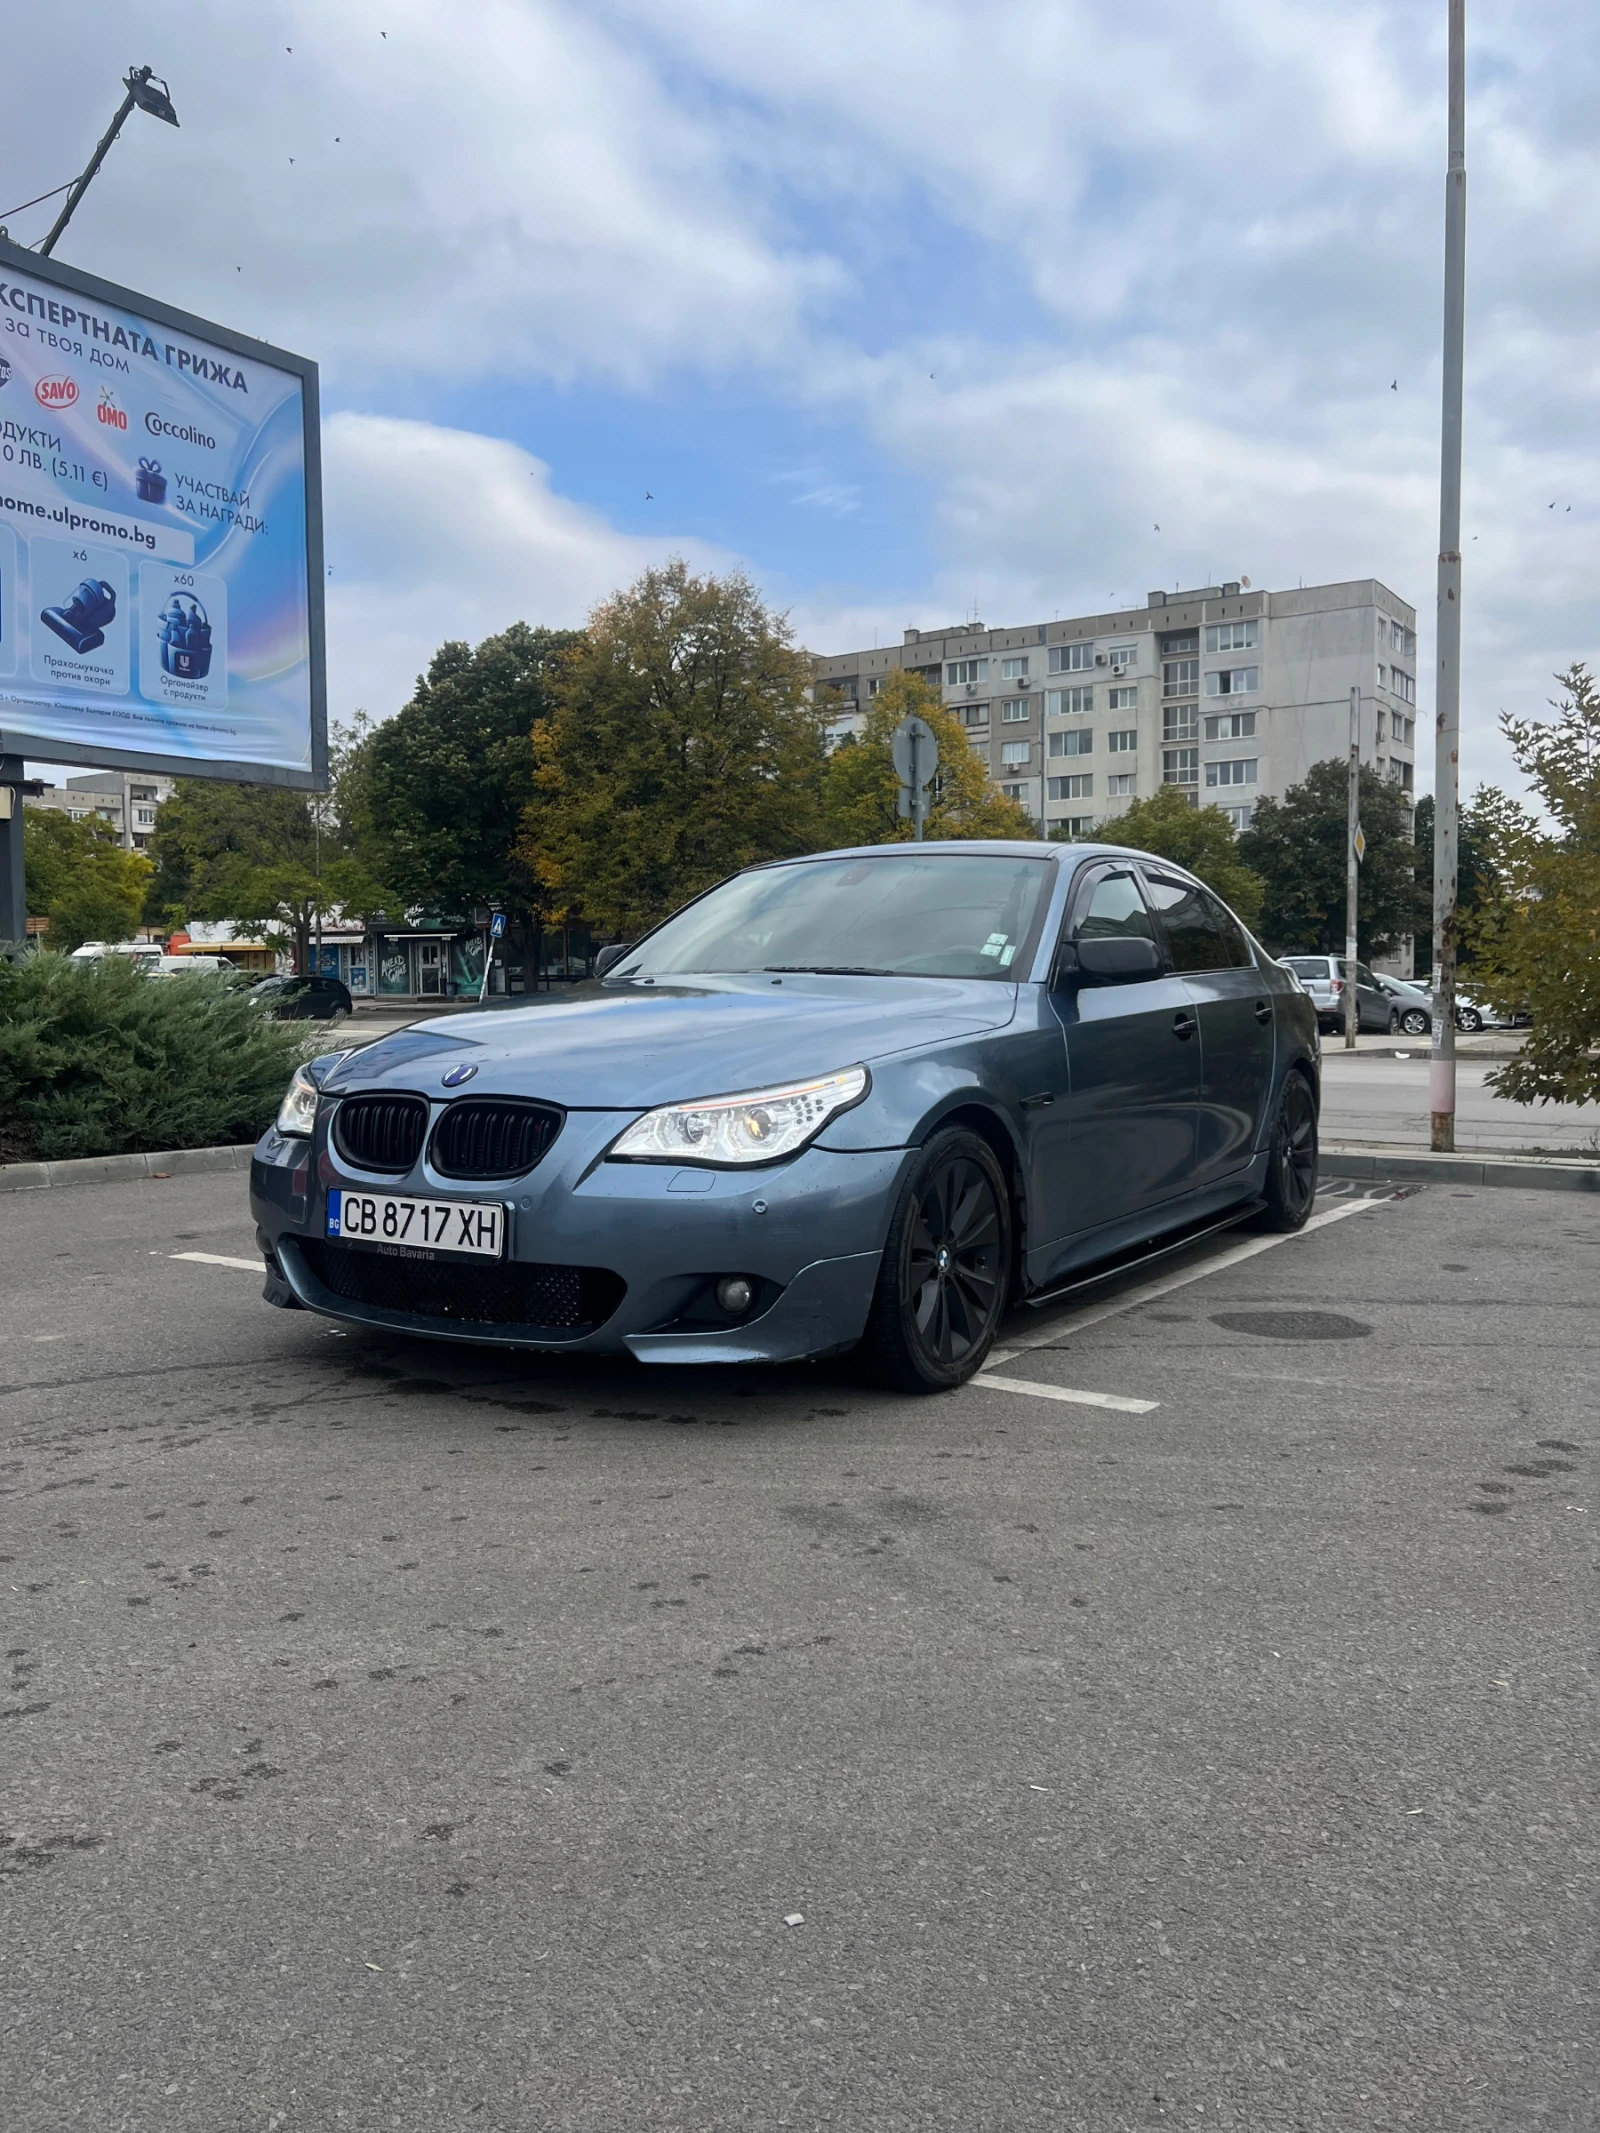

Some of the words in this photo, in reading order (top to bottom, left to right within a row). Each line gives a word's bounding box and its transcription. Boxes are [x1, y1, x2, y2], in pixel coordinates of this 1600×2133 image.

[0, 366, 11, 380] OS
[165, 344, 248, 394] ГРИЖА
[41, 377, 76, 401] SAVO
[97, 404, 127, 430] OMO
[0, 420, 61, 453] ДУКТИ
[145, 412, 216, 449] Coccolino
[19, 449, 46, 472] ЛВ.
[52, 457, 84, 482] (5.11
[92, 470, 108, 492] €)
[175, 473, 250, 509] УЧАСТВАЙ
[176, 495, 196, 515] ЗА
[200, 502, 268, 535] НАГРАДИ:
[174, 574, 194, 587] x60
[43, 654, 114, 676] Прахосмукачка
[51, 669, 82, 680] против
[84, 675, 111, 687] акари
[160, 675, 208, 694] Органайзер
[169, 689, 206, 702] продукти
[329, 1217, 340, 1229] BG
[345, 1197, 376, 1234] CB
[383, 1202, 451, 1243] 8717
[458, 1208, 496, 1249] XH
[377, 1243, 398, 1257] Auto
[400, 1247, 435, 1261] Bavaria
